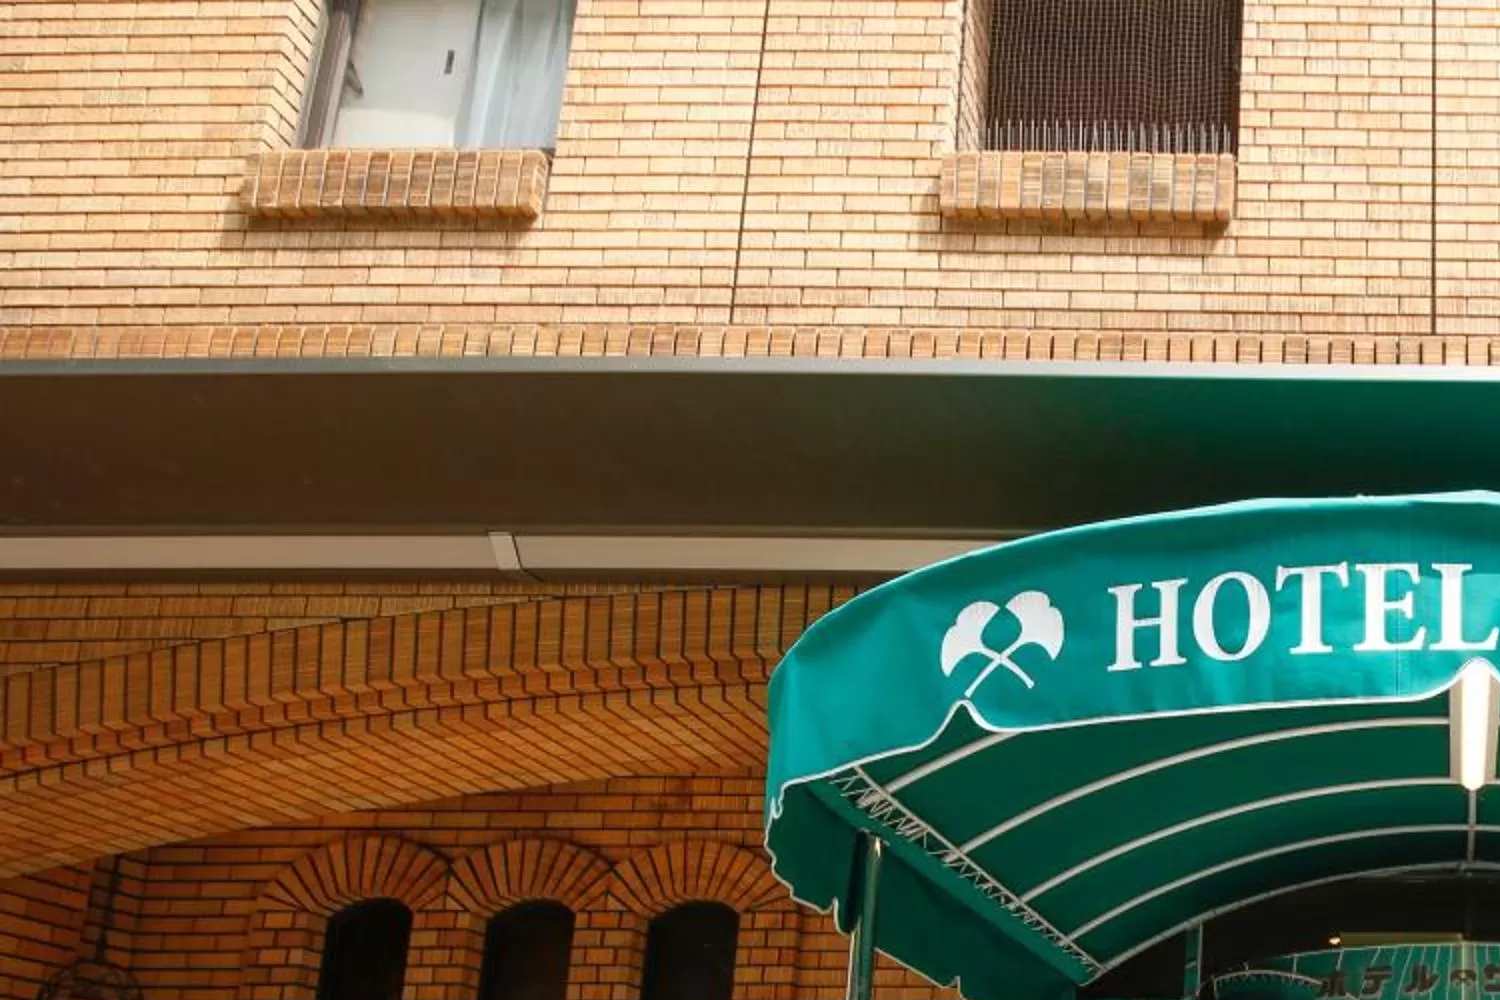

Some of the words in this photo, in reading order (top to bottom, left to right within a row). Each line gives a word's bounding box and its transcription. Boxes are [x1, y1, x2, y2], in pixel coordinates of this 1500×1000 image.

[1108, 561, 1500, 671] HOTEL
[1317, 964, 1440, 999] ホテル
